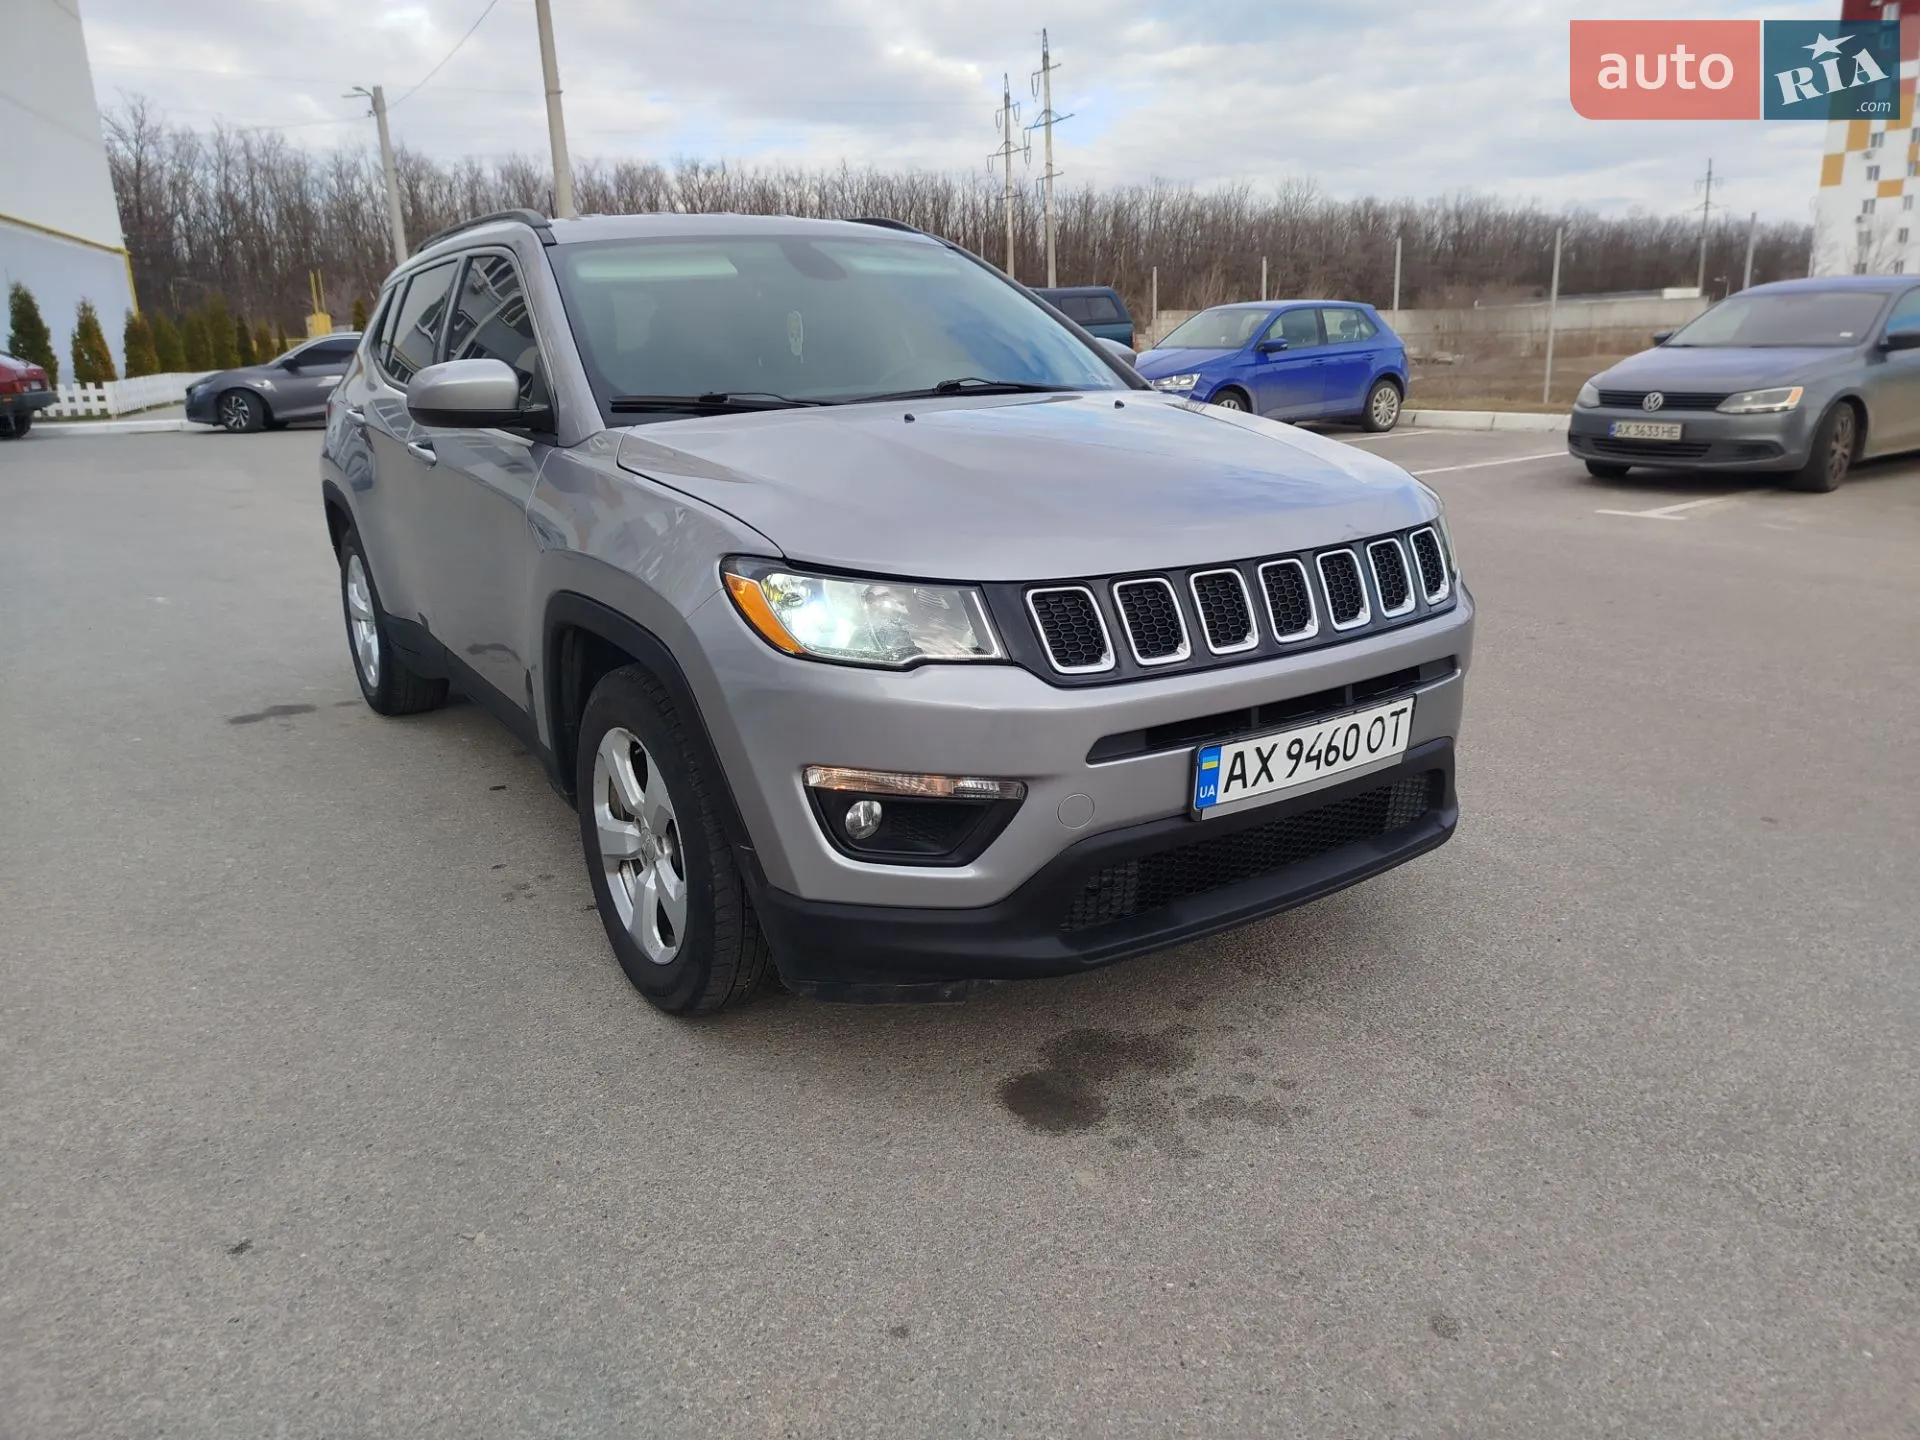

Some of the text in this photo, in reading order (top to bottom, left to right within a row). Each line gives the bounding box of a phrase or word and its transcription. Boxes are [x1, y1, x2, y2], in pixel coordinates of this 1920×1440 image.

[1616, 423, 1631, 435] AX
[1223, 707, 1408, 793] AX 9460 OT
[1199, 784, 1216, 799] UA
